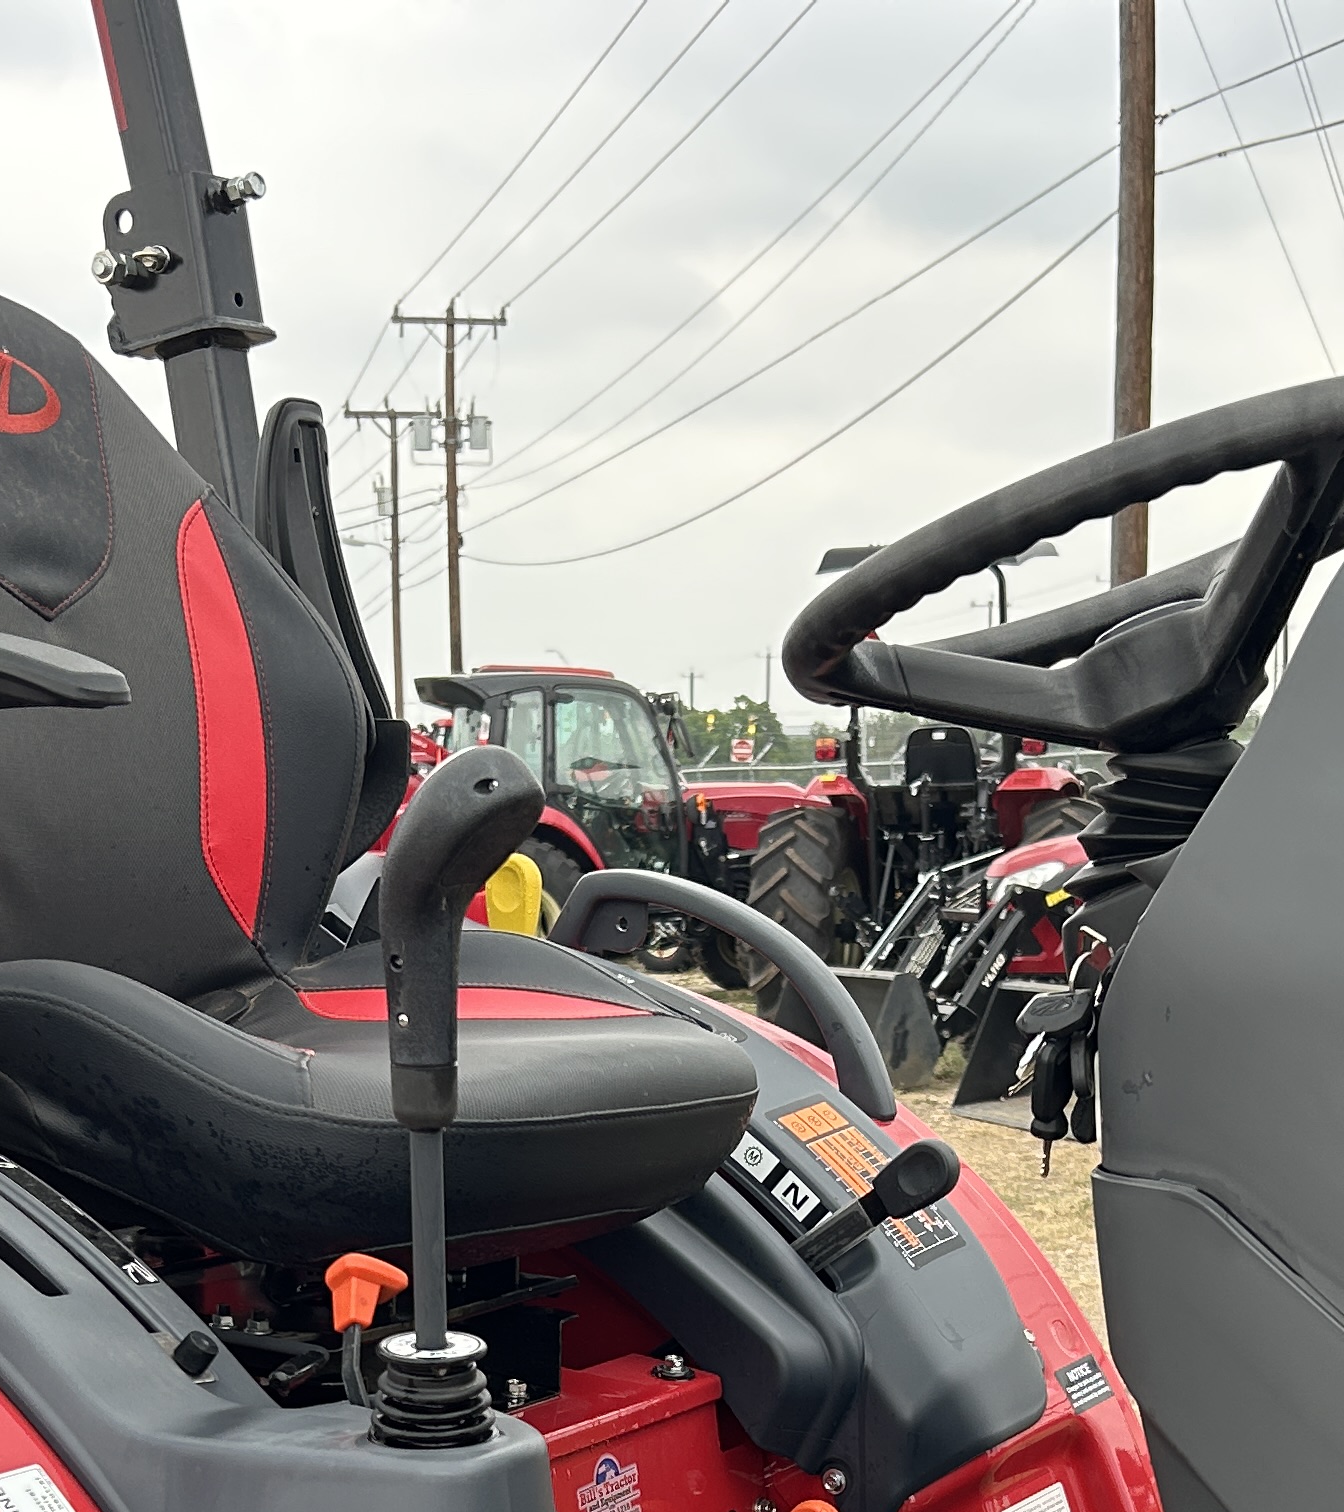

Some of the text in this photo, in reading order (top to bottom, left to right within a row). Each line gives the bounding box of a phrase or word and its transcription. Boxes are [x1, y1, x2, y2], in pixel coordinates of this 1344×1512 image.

[782, 1182, 810, 1211] N
[580, 1472, 637, 1507] Bill's Tractor
